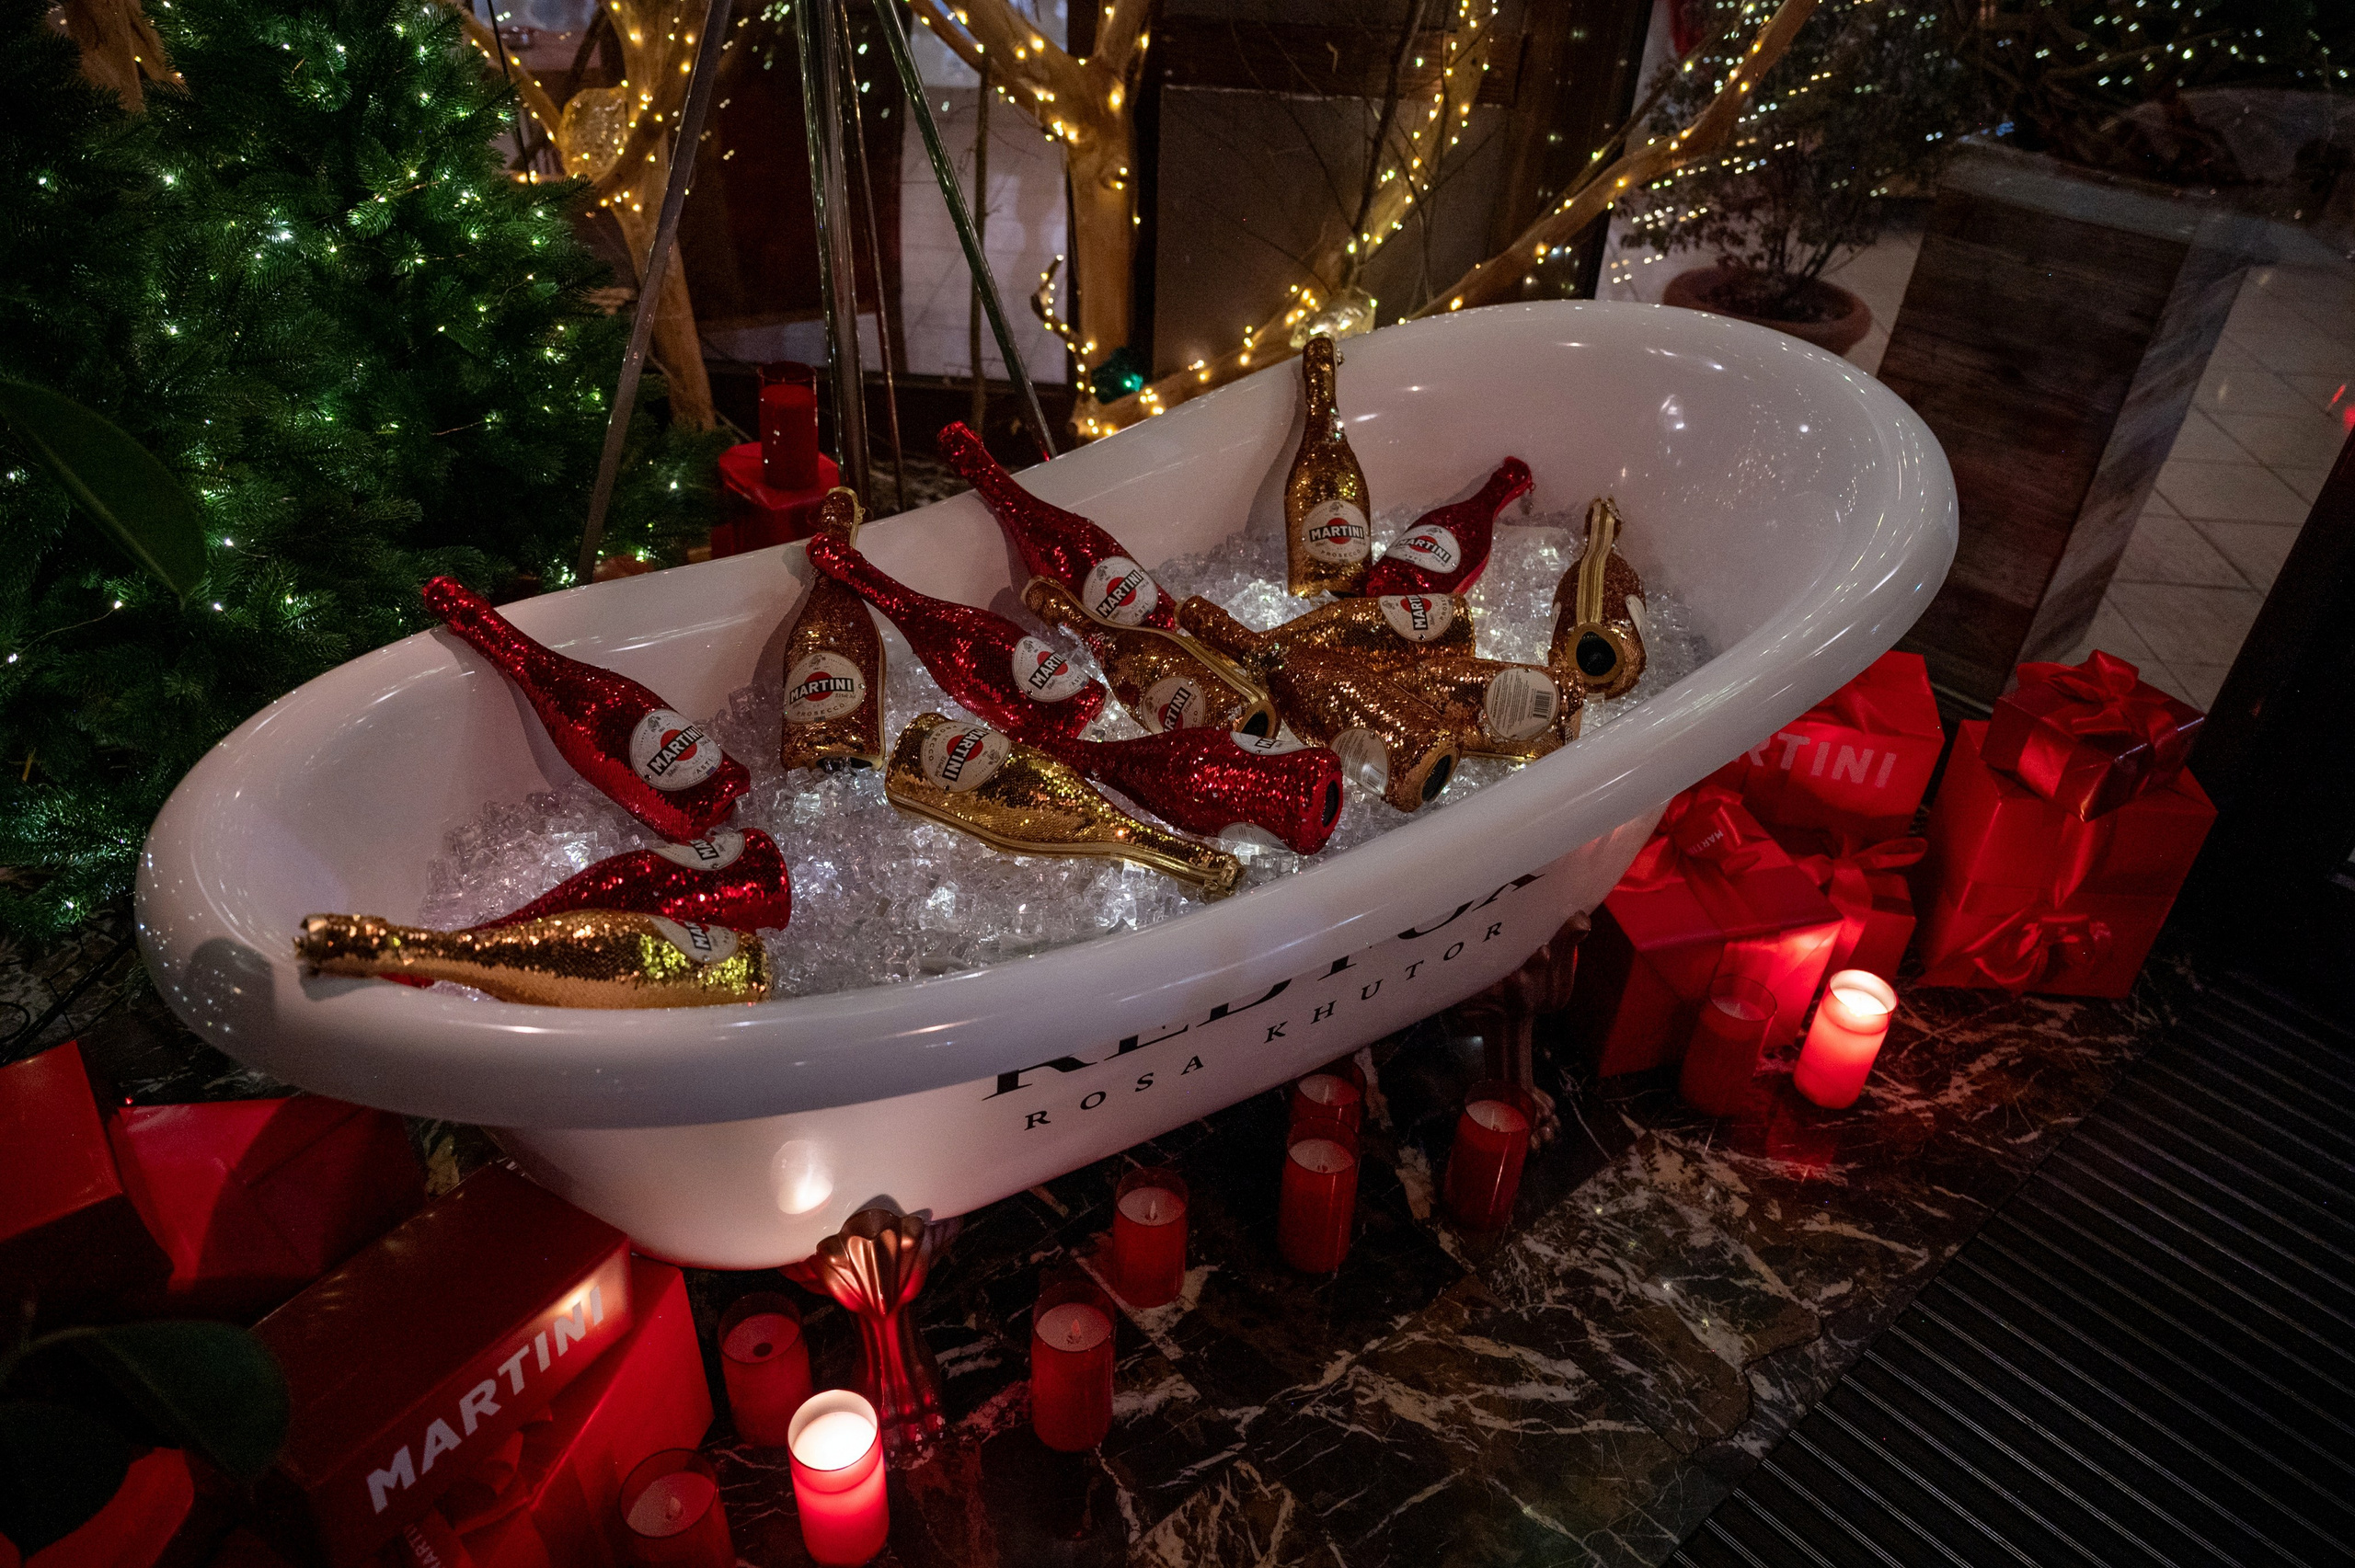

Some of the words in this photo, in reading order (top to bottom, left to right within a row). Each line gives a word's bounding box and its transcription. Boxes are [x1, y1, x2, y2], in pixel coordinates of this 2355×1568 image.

[1311, 525, 1363, 541] MARTINI
[1397, 539, 1450, 562] MARTINI
[1097, 571, 1142, 616] MARTINI
[1407, 595, 1427, 628] MARTI
[1031, 654, 1063, 686] MARTI
[791, 679, 852, 703] MARTINI
[649, 727, 703, 773] MARTINI
[695, 758, 713, 774] ASTI
[945, 728, 987, 778] MARTINI
[1734, 732, 1897, 788] RTINI
[1024, 1055, 1204, 1131] ROSA
[1263, 921, 1502, 1044] KHUTOR
[366, 1285, 604, 1516] MARTINI
